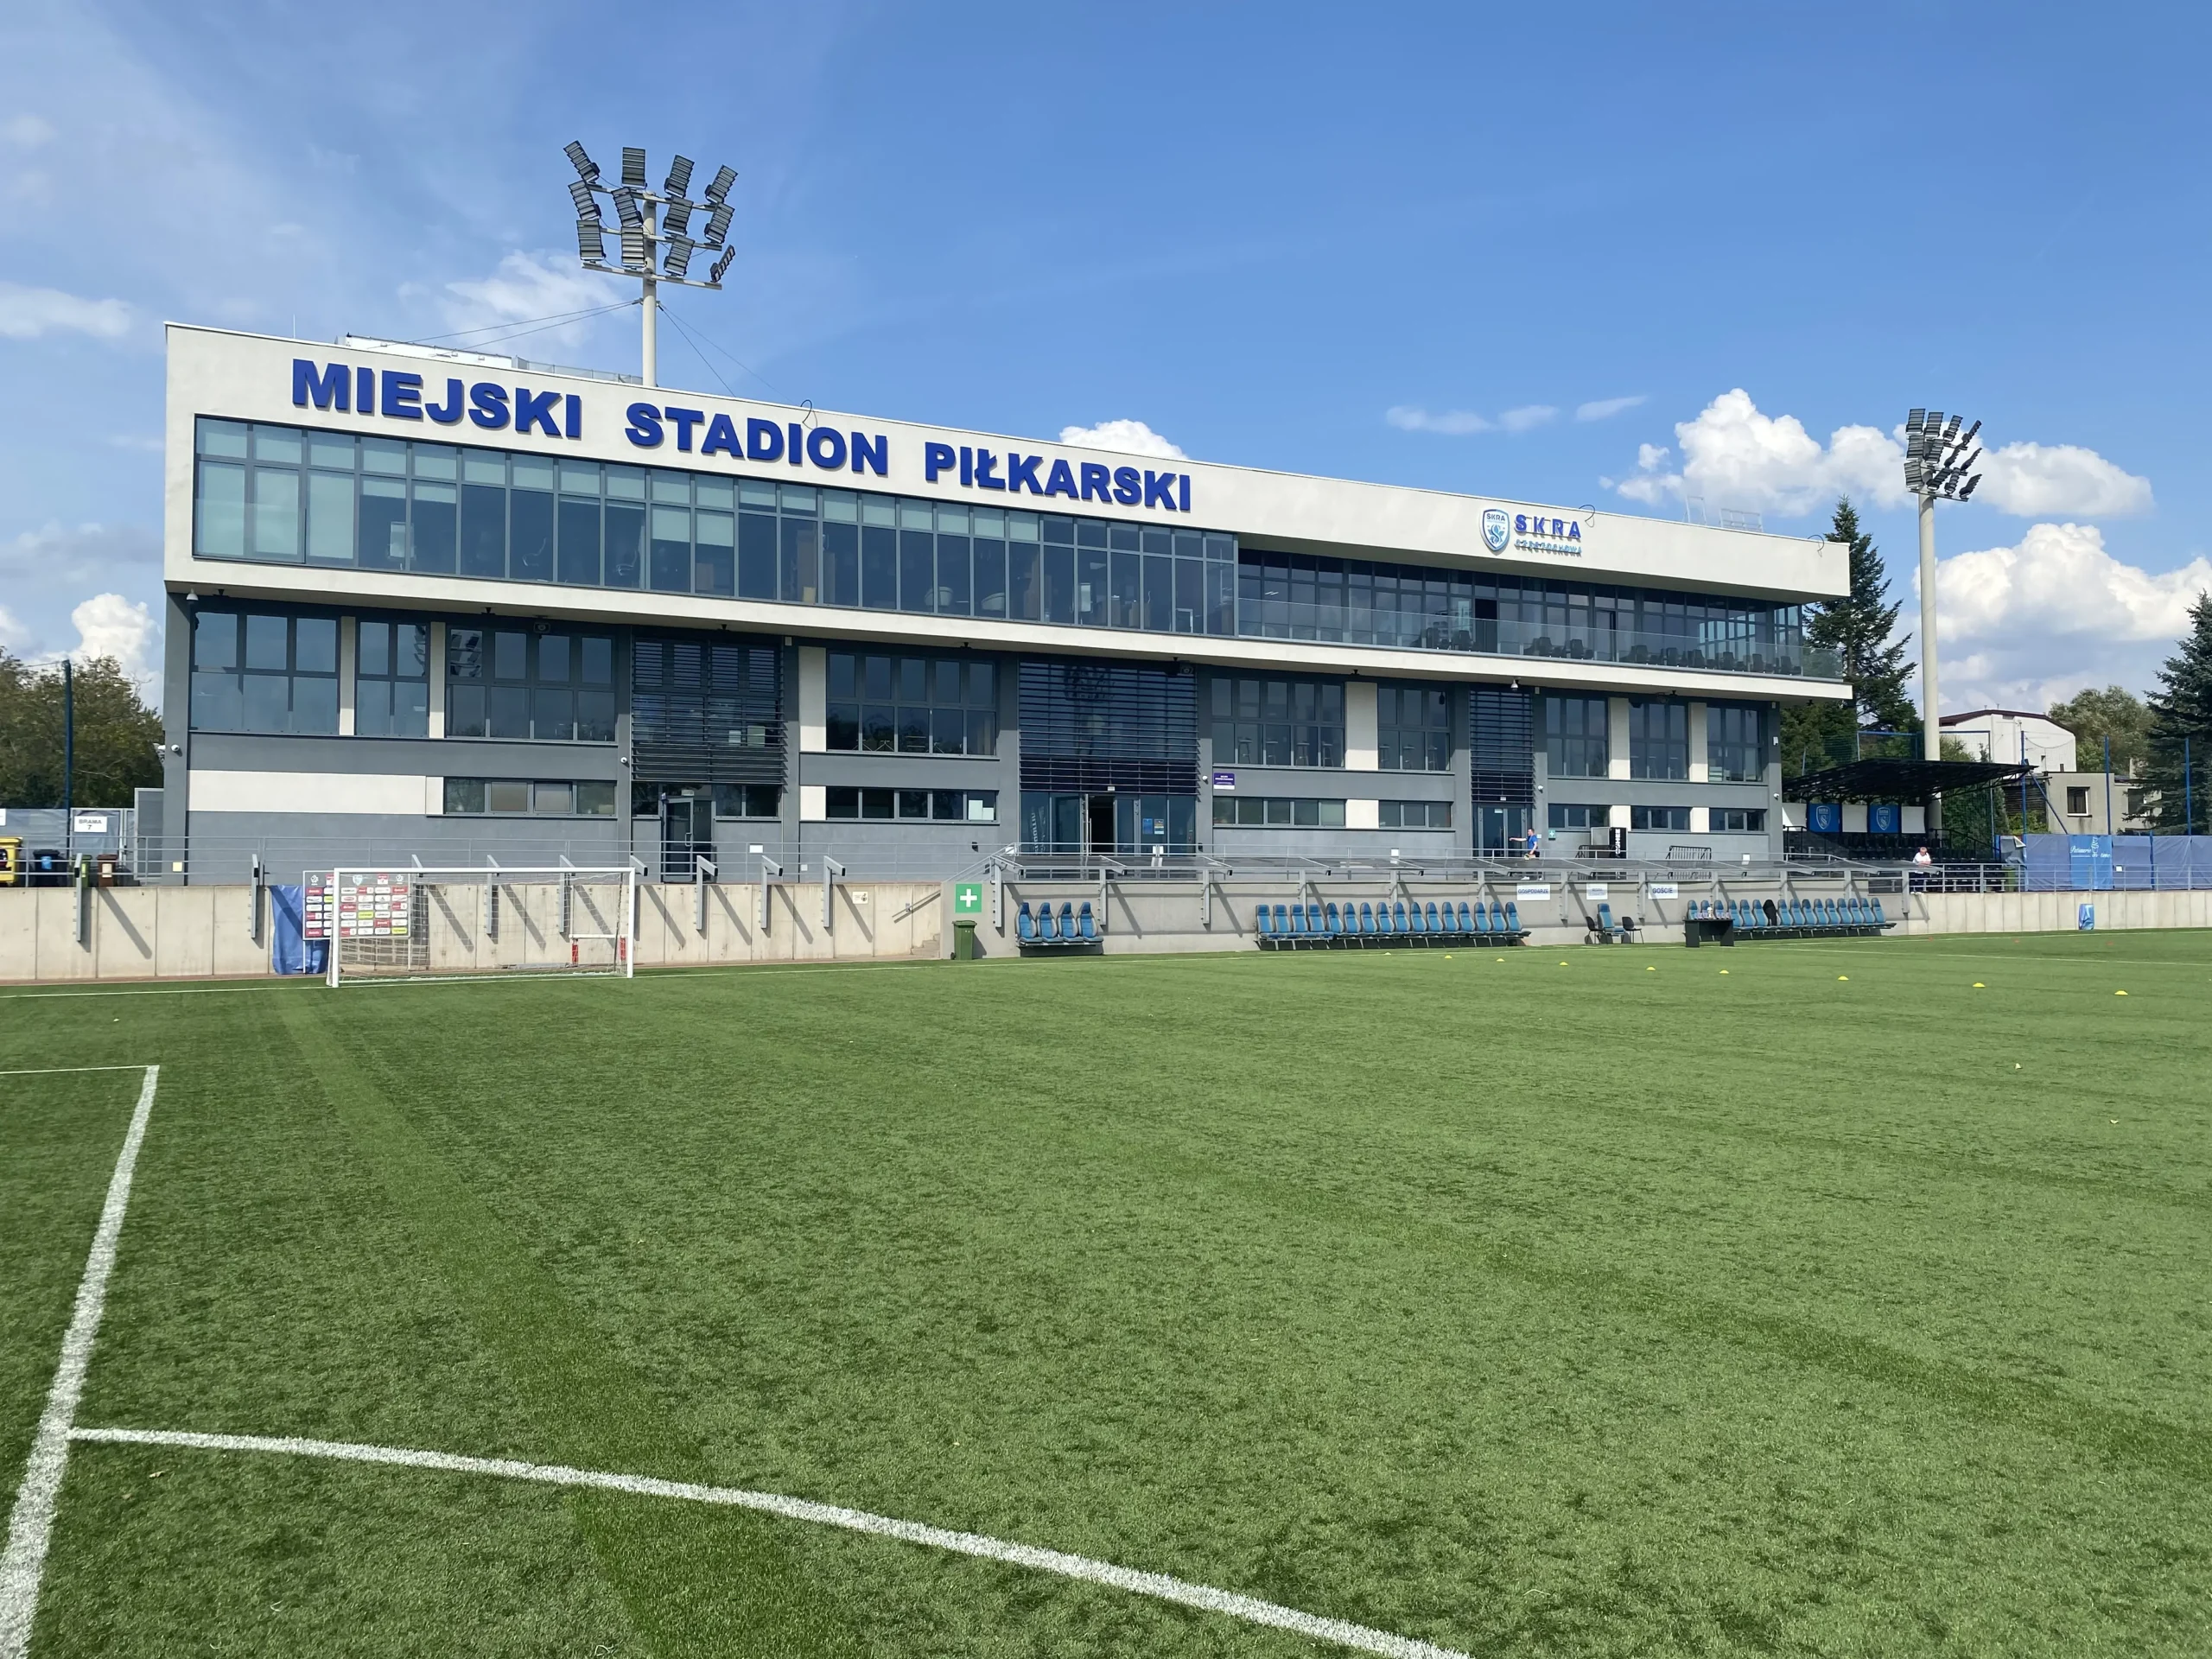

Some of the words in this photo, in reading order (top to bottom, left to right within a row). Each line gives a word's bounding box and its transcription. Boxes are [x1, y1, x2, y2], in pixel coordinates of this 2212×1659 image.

[292, 359, 582, 437] MIEJSKI
[625, 402, 888, 476] STADION
[925, 442, 1192, 512] PIŁKARSKI
[1486, 513, 1506, 522] SKRA
[1516, 514, 1581, 538] SKRA
